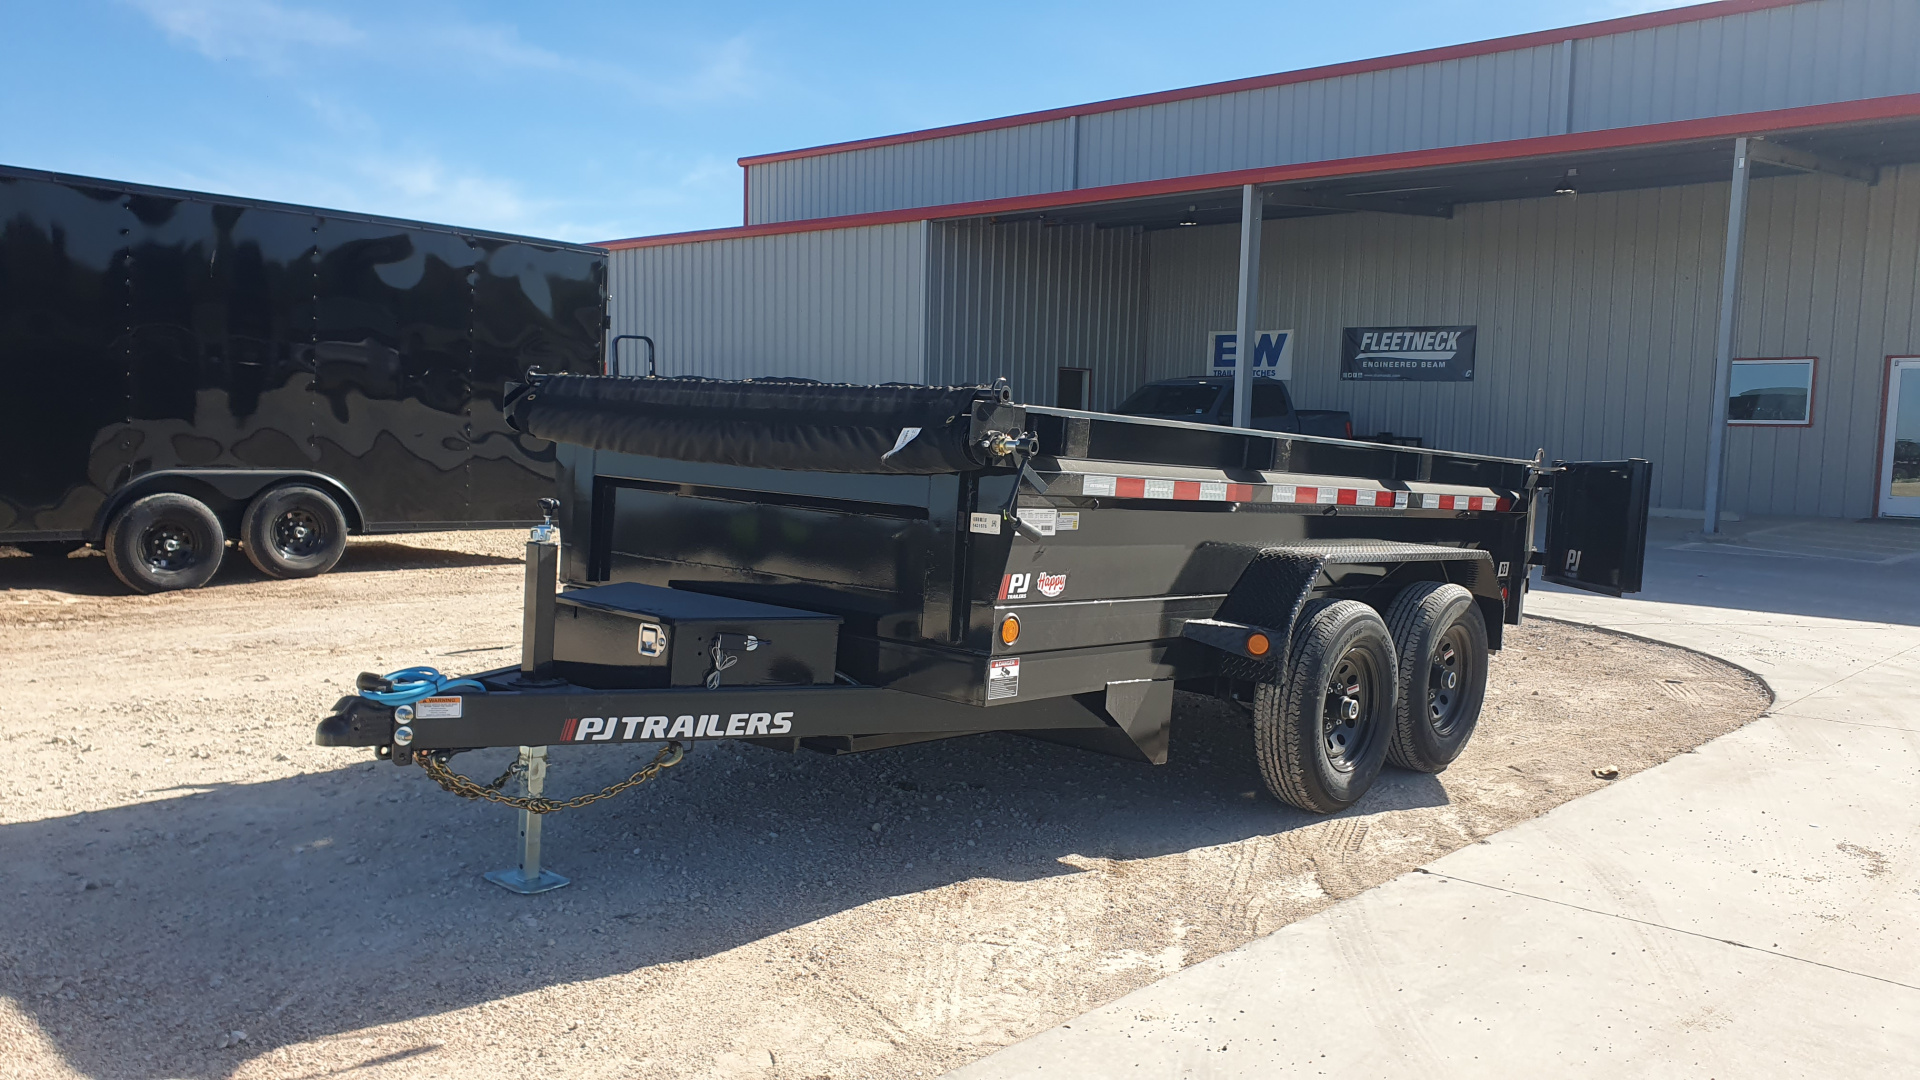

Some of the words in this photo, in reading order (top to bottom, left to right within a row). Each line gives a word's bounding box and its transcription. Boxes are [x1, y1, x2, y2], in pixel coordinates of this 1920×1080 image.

[1360, 331, 1461, 351] FLEETNECK
[1565, 549, 1581, 571] PJ
[1008, 573, 1031, 593] PJ
[1038, 573, 1066, 591] Happy
[575, 717, 618, 741] PJ
[622, 711, 794, 740] TRAILERS
